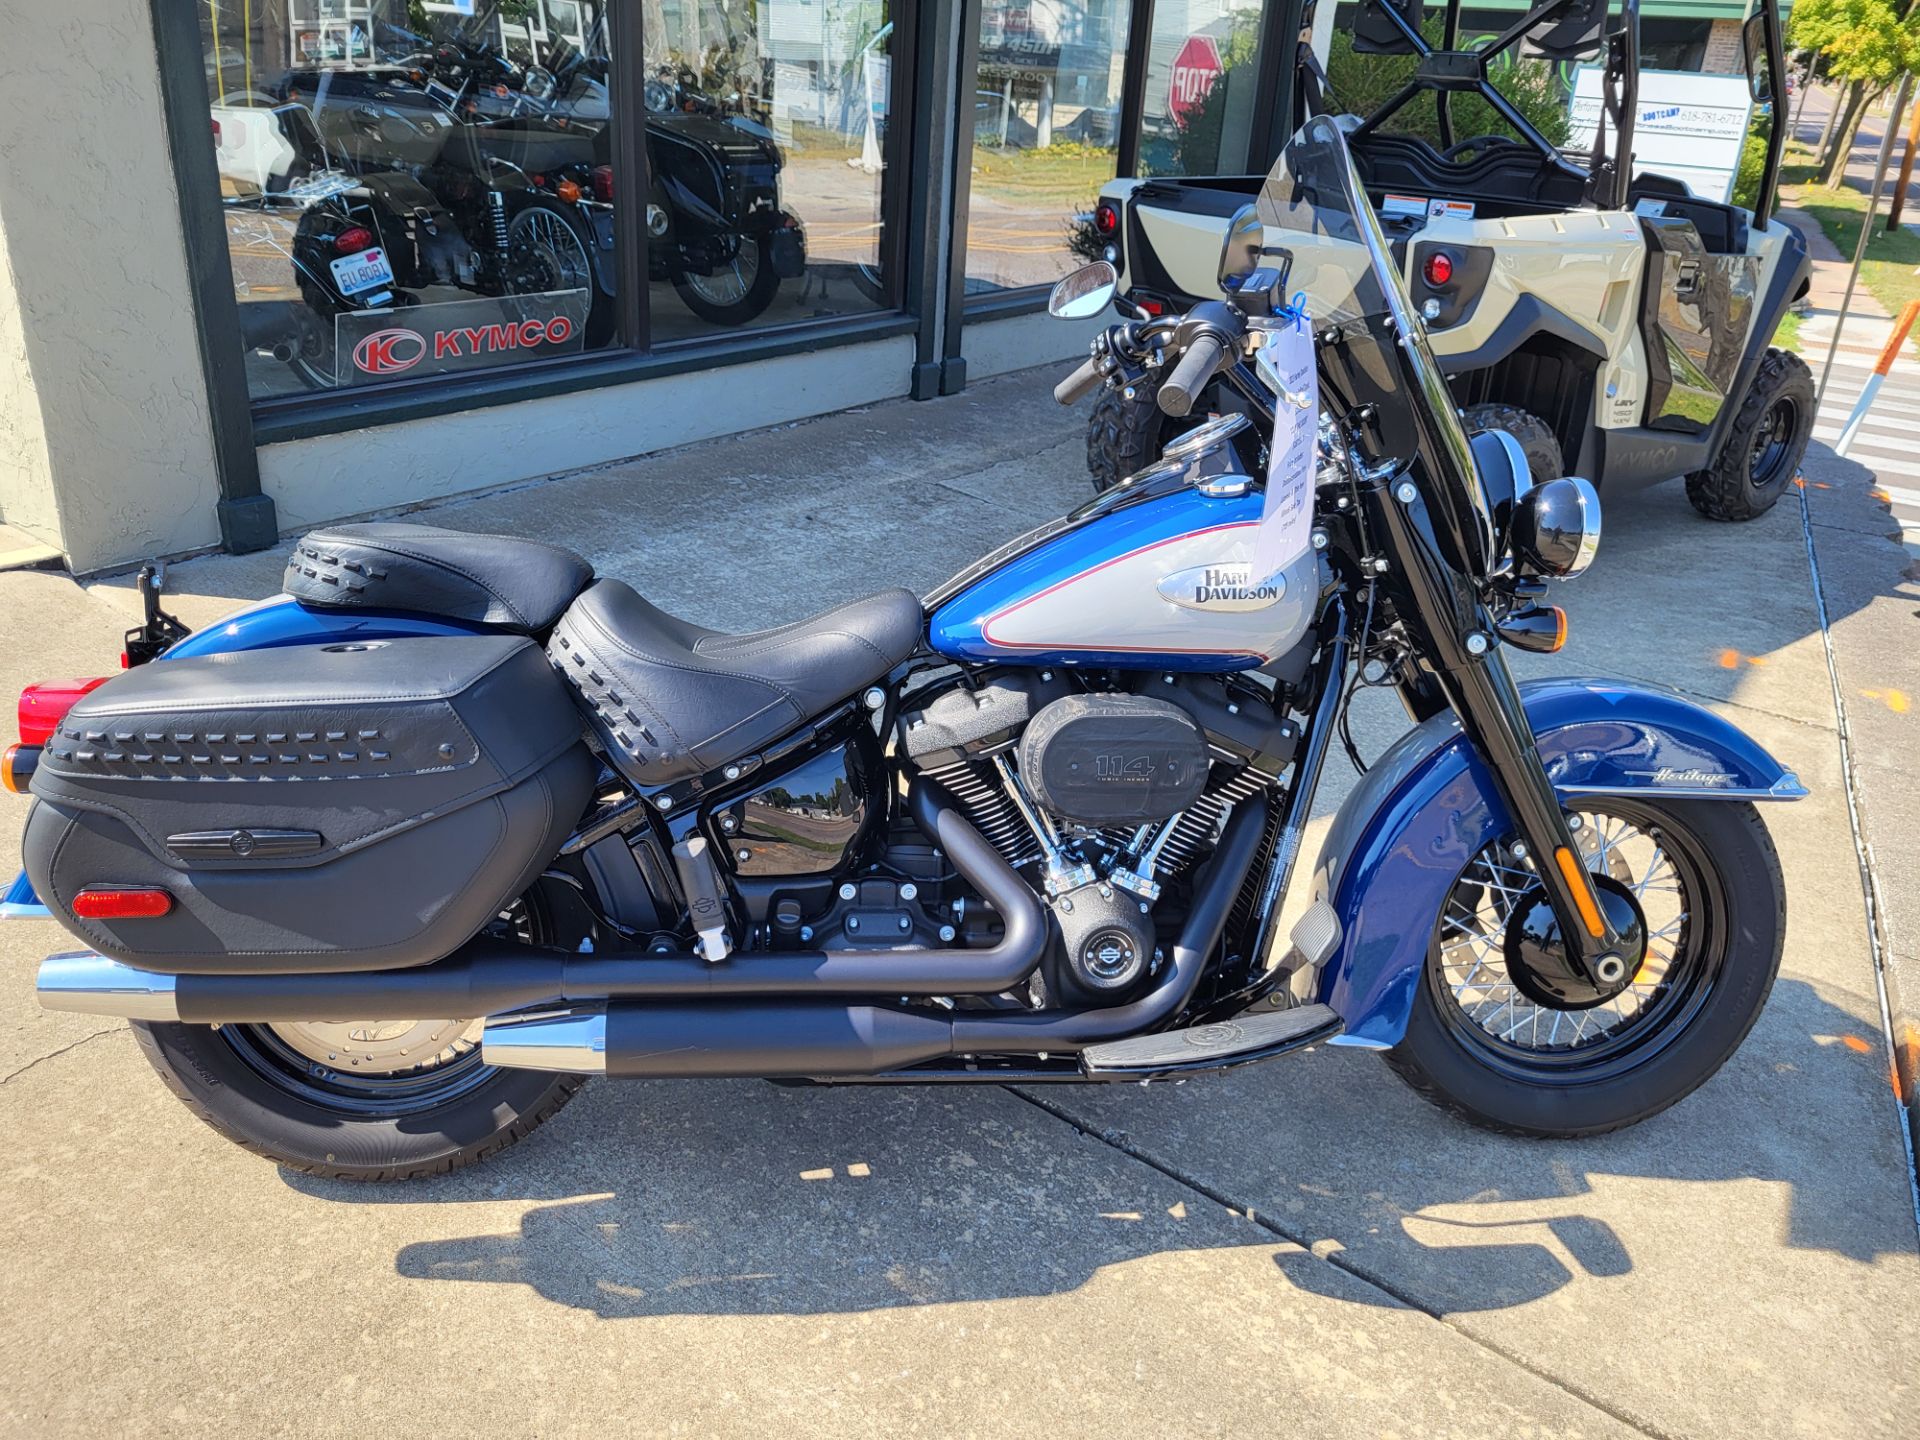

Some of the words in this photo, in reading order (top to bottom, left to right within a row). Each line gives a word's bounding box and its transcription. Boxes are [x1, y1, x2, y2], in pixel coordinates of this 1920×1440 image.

[1643, 107, 1680, 121] BOOTCAMP
[434, 316, 572, 360] KYMCO
[1195, 586, 1278, 604] DAVIDSON
[1096, 755, 1155, 777] 114
[1654, 766, 1724, 786] Heritage
